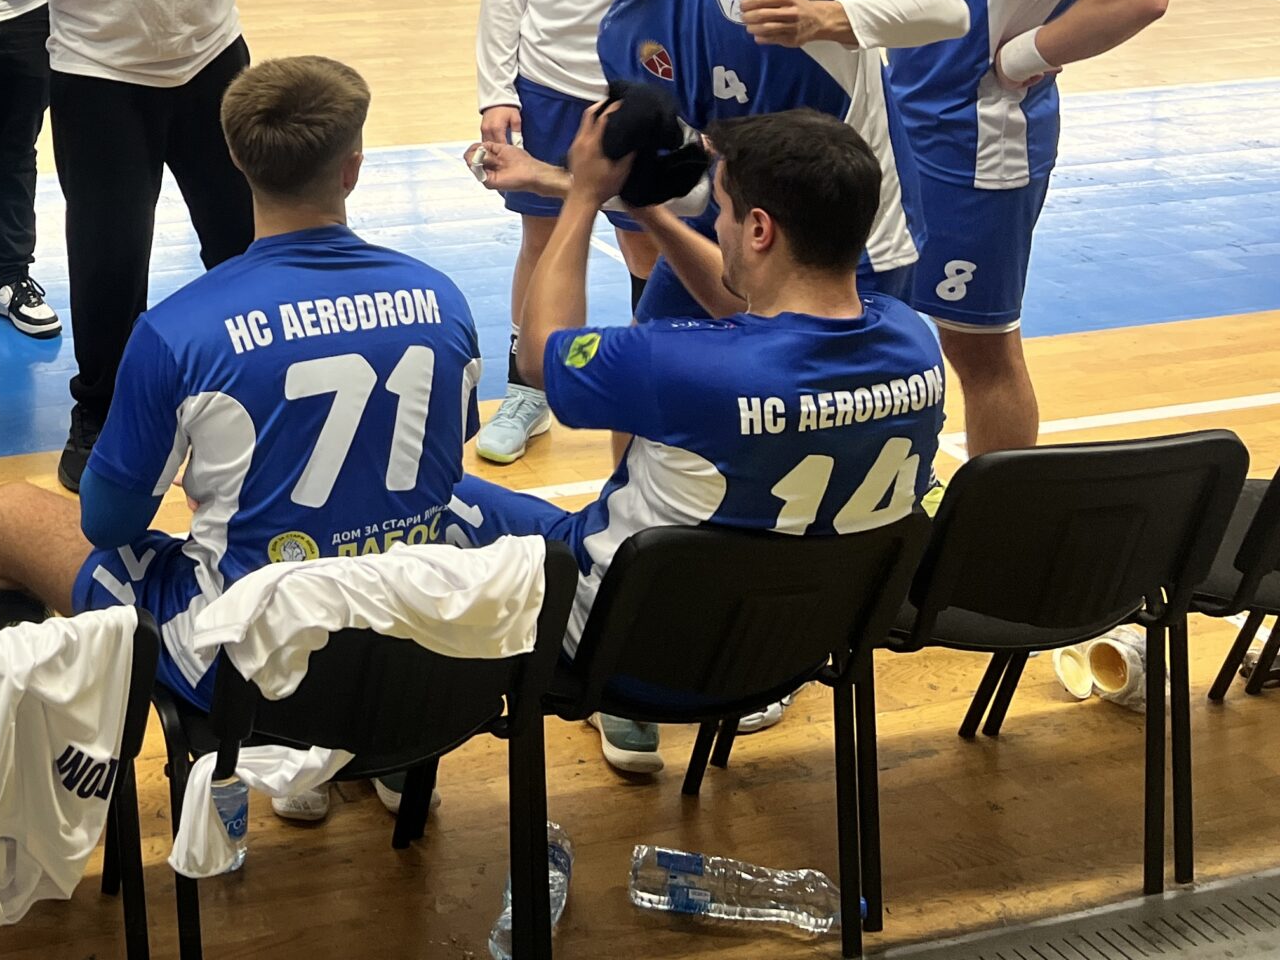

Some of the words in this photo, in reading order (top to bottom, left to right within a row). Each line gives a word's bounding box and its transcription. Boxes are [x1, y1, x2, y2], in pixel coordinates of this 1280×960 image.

[713, 64, 750, 104] 4
[935, 260, 977, 301] 8
[224, 310, 274, 354] HC
[278, 288, 442, 340] AERODROM
[284, 345, 435, 508] 71
[737, 396, 787, 435] HC
[798, 365, 944, 432] AERODROM
[767, 437, 920, 536] 14
[331, 529, 361, 545] ДОМ
[364, 524, 379, 536] ЗА
[382, 515, 421, 531] СТАРИ
